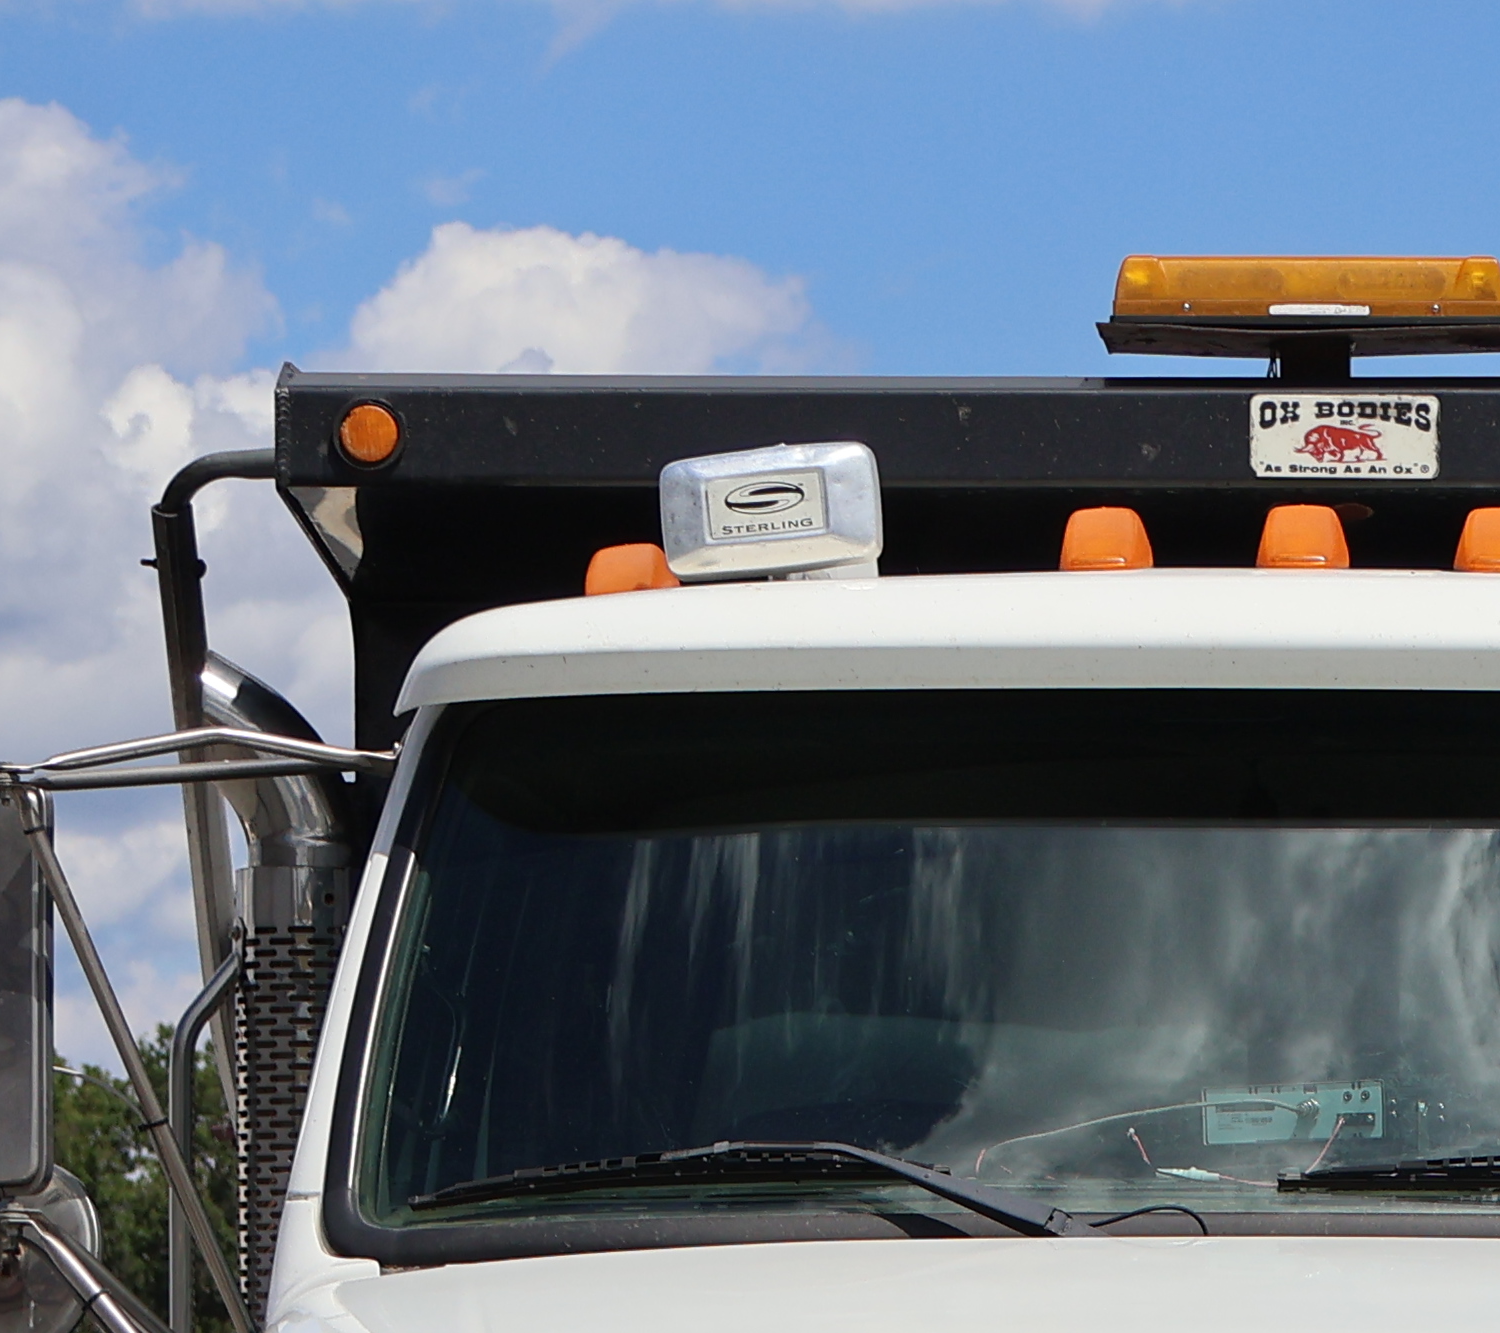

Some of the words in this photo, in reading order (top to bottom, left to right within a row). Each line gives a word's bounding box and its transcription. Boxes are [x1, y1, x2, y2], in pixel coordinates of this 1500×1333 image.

[1259, 401, 1300, 429] OX
[1314, 402, 1431, 432] BODIES
[1289, 464, 1337, 474] Strong
[1343, 465, 1362, 473] As
[1368, 465, 1387, 474] An
[722, 518, 813, 535] STERLING
